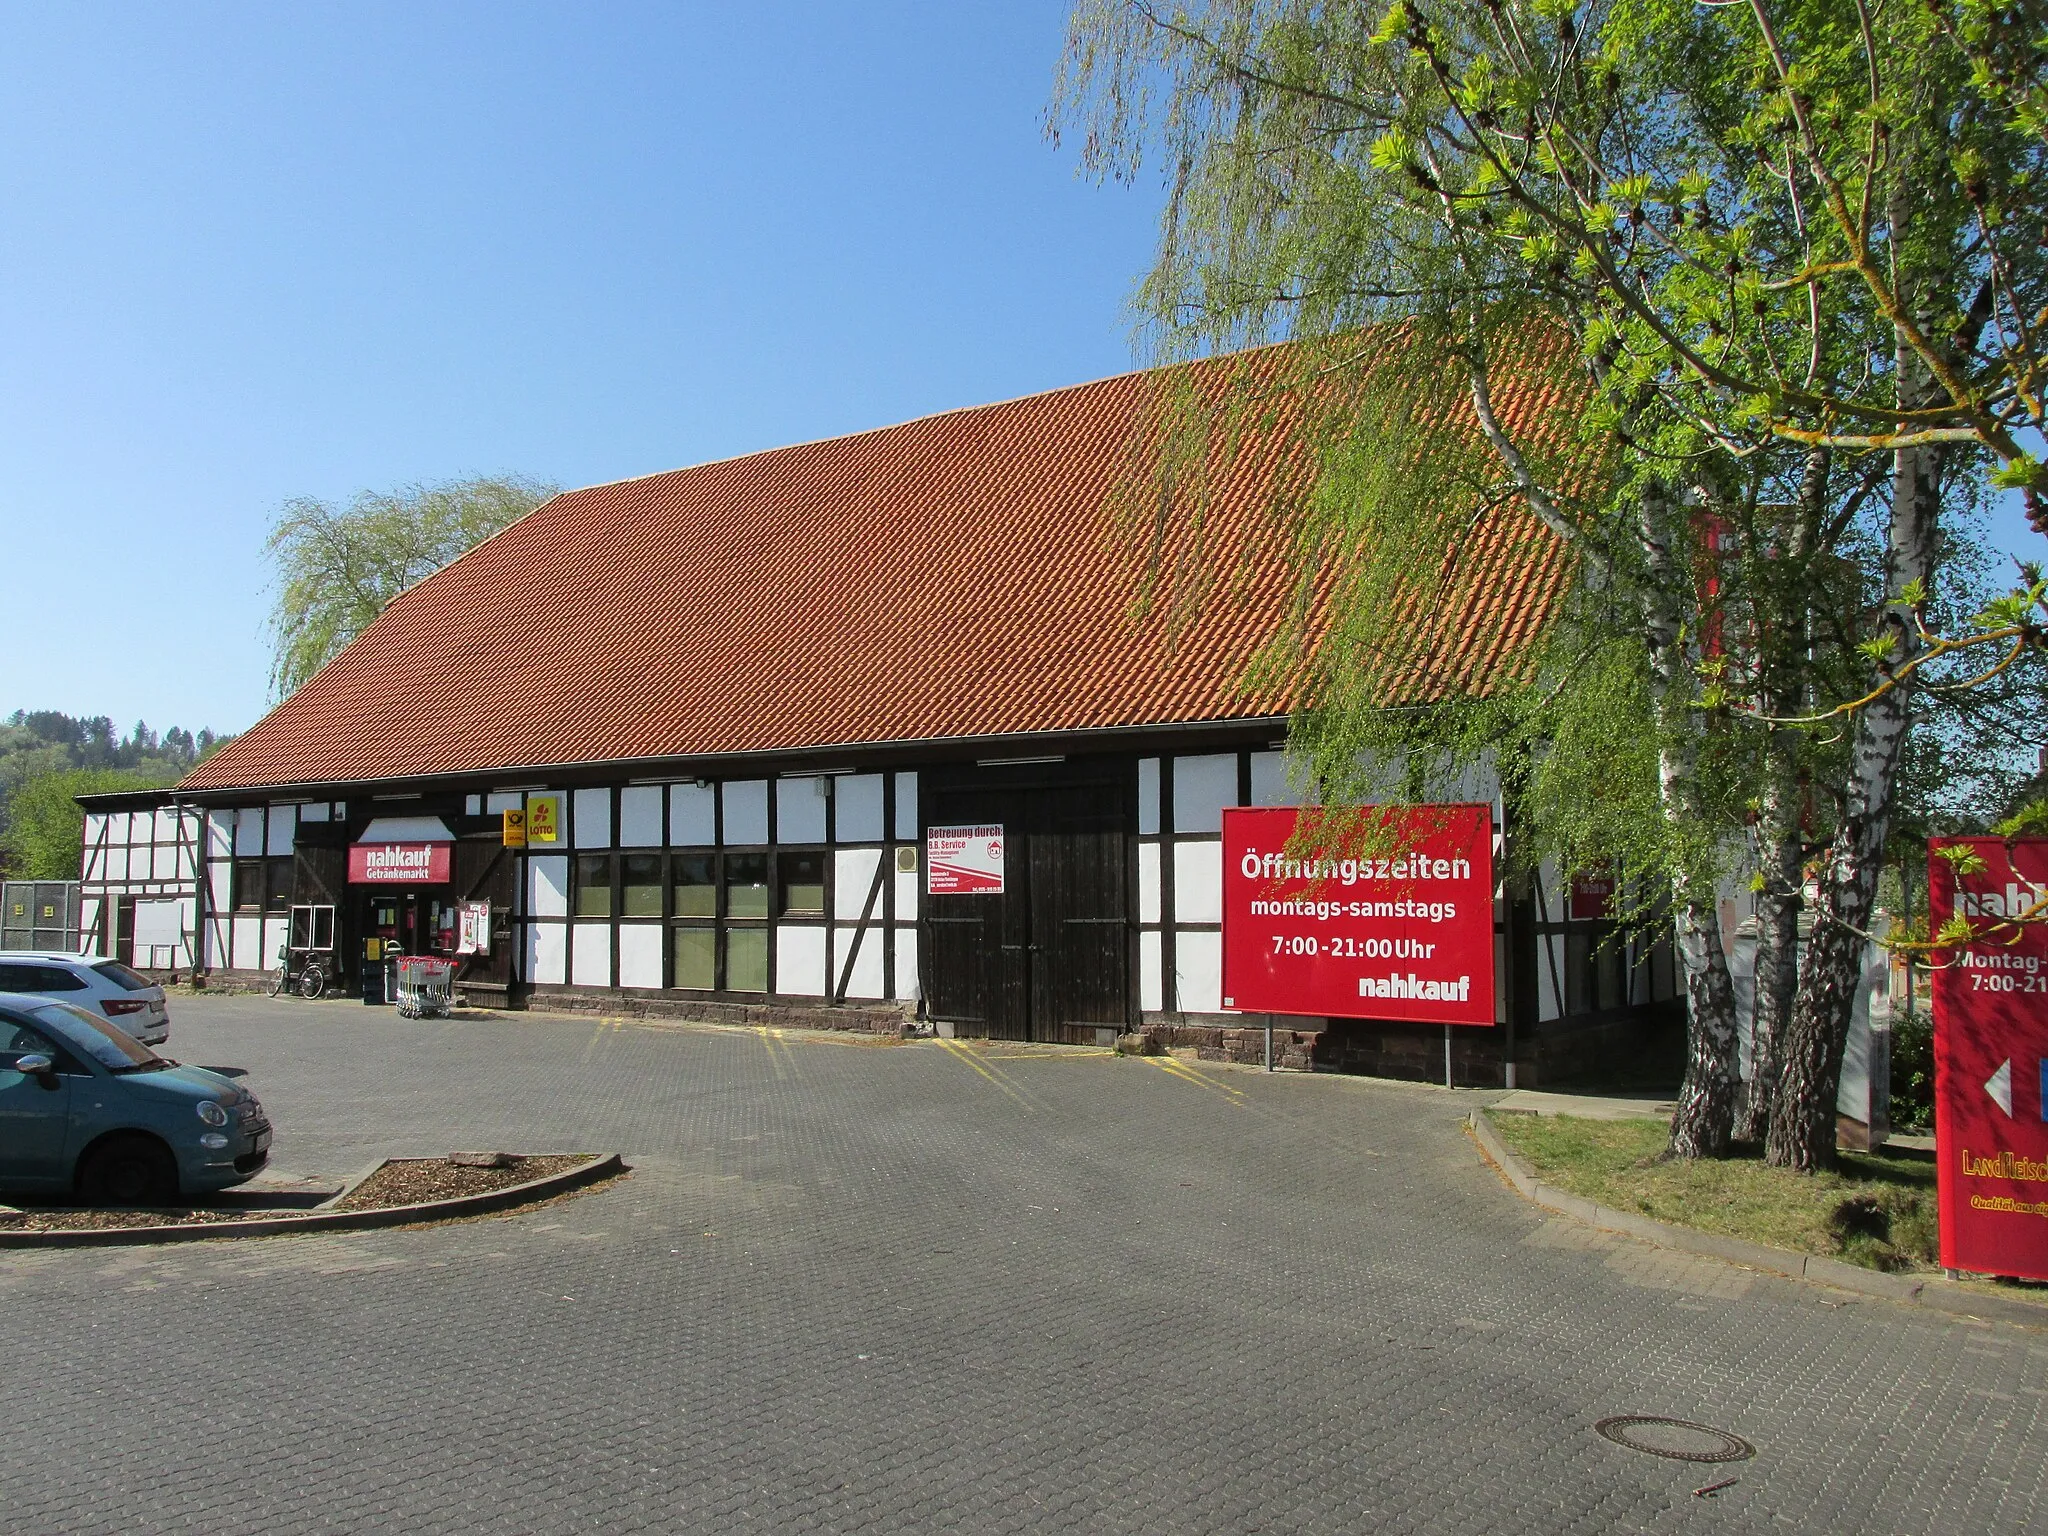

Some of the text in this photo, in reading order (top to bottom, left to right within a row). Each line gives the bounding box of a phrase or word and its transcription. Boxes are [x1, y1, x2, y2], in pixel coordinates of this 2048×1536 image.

[530, 826, 553, 835] LOTTO
[928, 826, 1003, 839] Betreuung durch:
[941, 840, 966, 849] Service
[366, 844, 432, 867] nahkauf
[366, 867, 429, 879] Getränkemarkt
[1241, 848, 1470, 886] Öffnungszeiten
[1251, 898, 1456, 922] montags-samstags
[1358, 972, 1470, 1002] nahkauf
[1971, 1195, 2013, 1212] Qualität
[2014, 1202, 2034, 1213] aus
